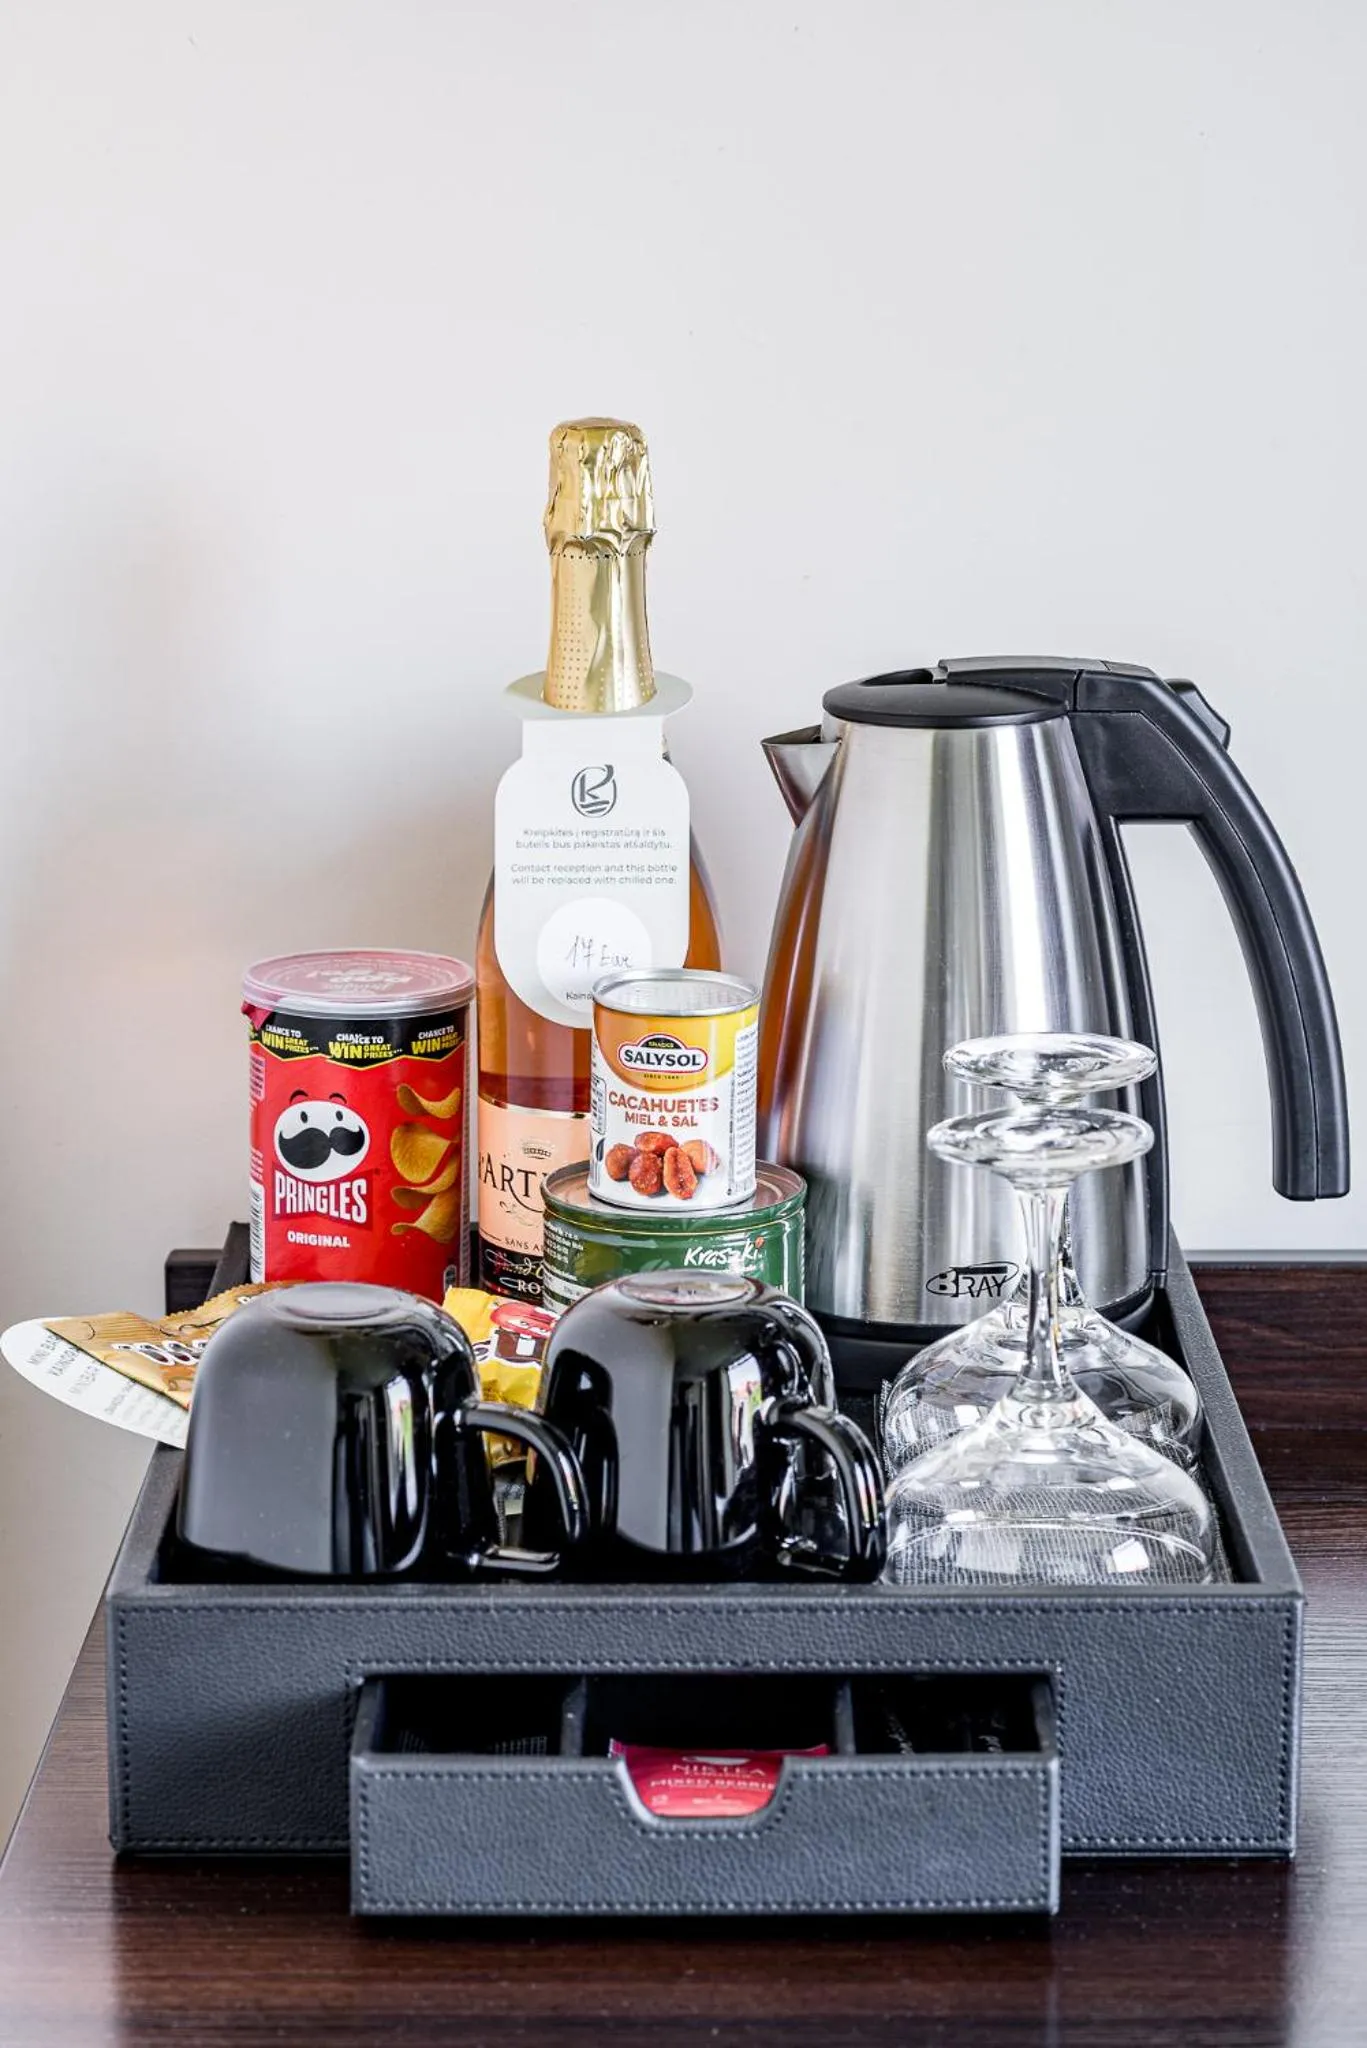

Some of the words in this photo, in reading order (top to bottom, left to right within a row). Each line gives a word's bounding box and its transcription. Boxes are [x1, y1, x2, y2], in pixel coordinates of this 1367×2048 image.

[553, 840, 572, 850] bus
[510, 863, 551, 874] Contact
[553, 863, 602, 876] reception
[604, 863, 624, 874] and
[626, 863, 646, 874] this
[647, 863, 679, 874] bottle
[512, 875, 530, 886] will
[531, 875, 545, 886] be
[547, 875, 591, 888] replaced
[594, 875, 618, 886] with
[618, 875, 652, 886] chilled
[261, 1030, 285, 1050] WIN
[265, 1024, 290, 1037] CHANCE
[290, 1029, 302, 1039] TO
[336, 1033, 371, 1044] CHANCE
[371, 1036, 384, 1044] TO
[328, 1041, 363, 1059] WIN
[363, 1044, 392, 1053] GREAT
[363, 1051, 394, 1059] PRIZES
[411, 1037, 441, 1055] WIN
[623, 1049, 702, 1068] SALYSOL
[608, 1090, 720, 1114] CACAHUETES
[624, 1110, 655, 1126] MIEL
[658, 1115, 669, 1127] &
[671, 1115, 699, 1128] SAL
[274, 1169, 368, 1225] PRINGLES
[287, 1229, 351, 1249] ORIGINAL
[504, 1237, 530, 1250] SANS
